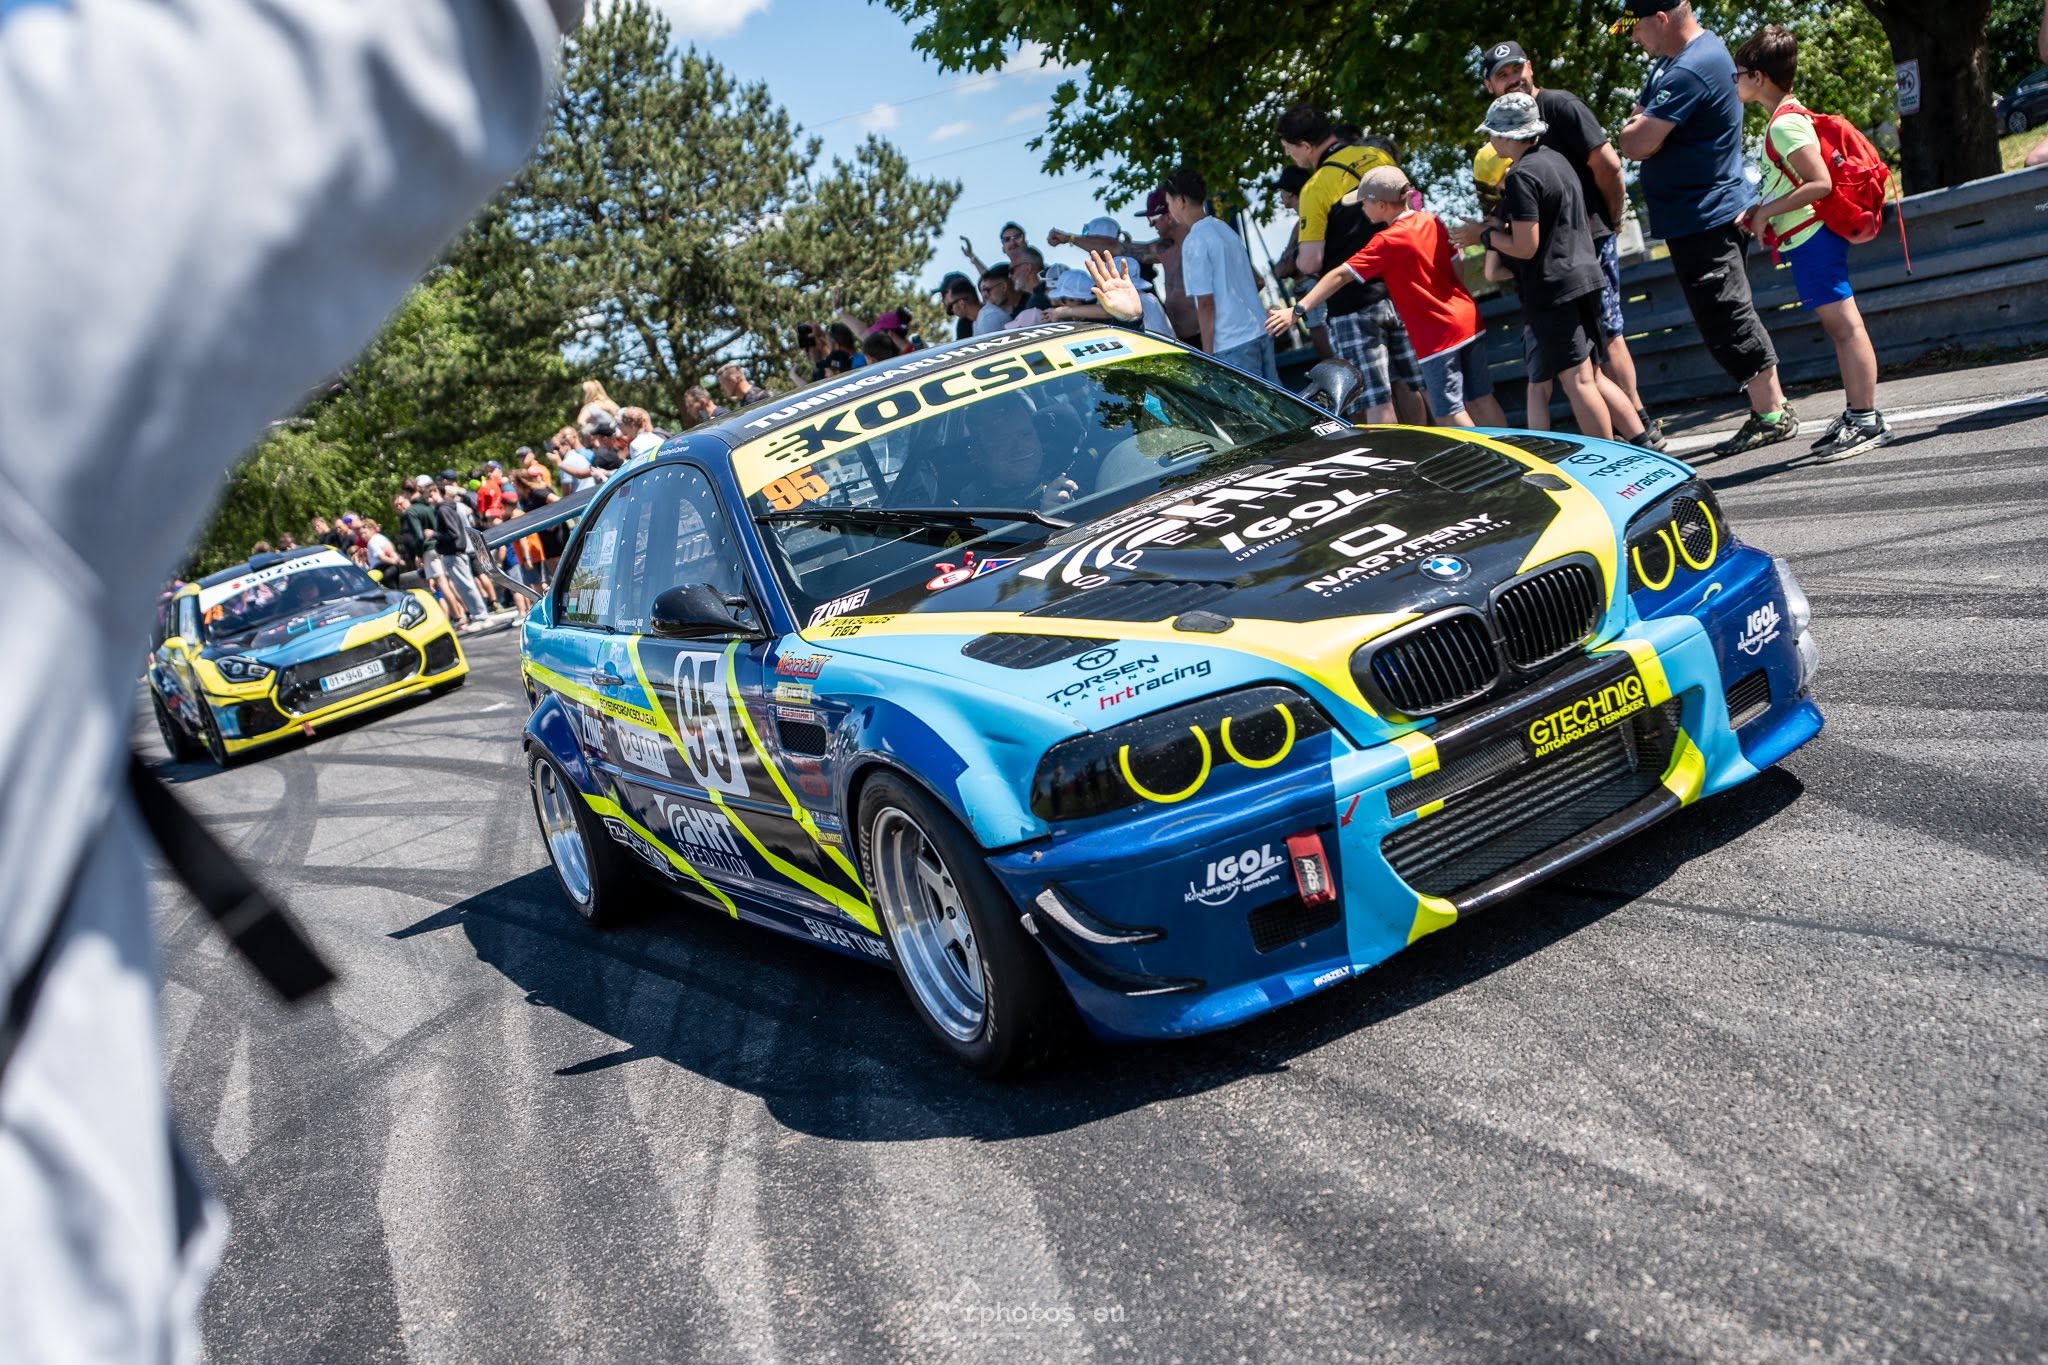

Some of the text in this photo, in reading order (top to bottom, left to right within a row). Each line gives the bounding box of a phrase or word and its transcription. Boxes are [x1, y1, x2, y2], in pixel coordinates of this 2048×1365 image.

[761, 466, 830, 511] 95
[1616, 468, 1677, 500] hrtracing
[1071, 458, 1417, 590] SPEDITION
[1235, 525, 1312, 562] LUBRIFIANTS
[245, 557, 322, 584] SUZUKI
[1321, 520, 1512, 598] COATING TECHNOLOGIES
[1046, 654, 1160, 703] TORSEN
[1063, 667, 1156, 708] RACING
[1099, 660, 1212, 710] hrtracing
[678, 655, 732, 784] 95
[1529, 675, 1644, 745] GTECHNIQ
[678, 841, 755, 880] SPEDITION
[804, 917, 856, 950] GYULA
